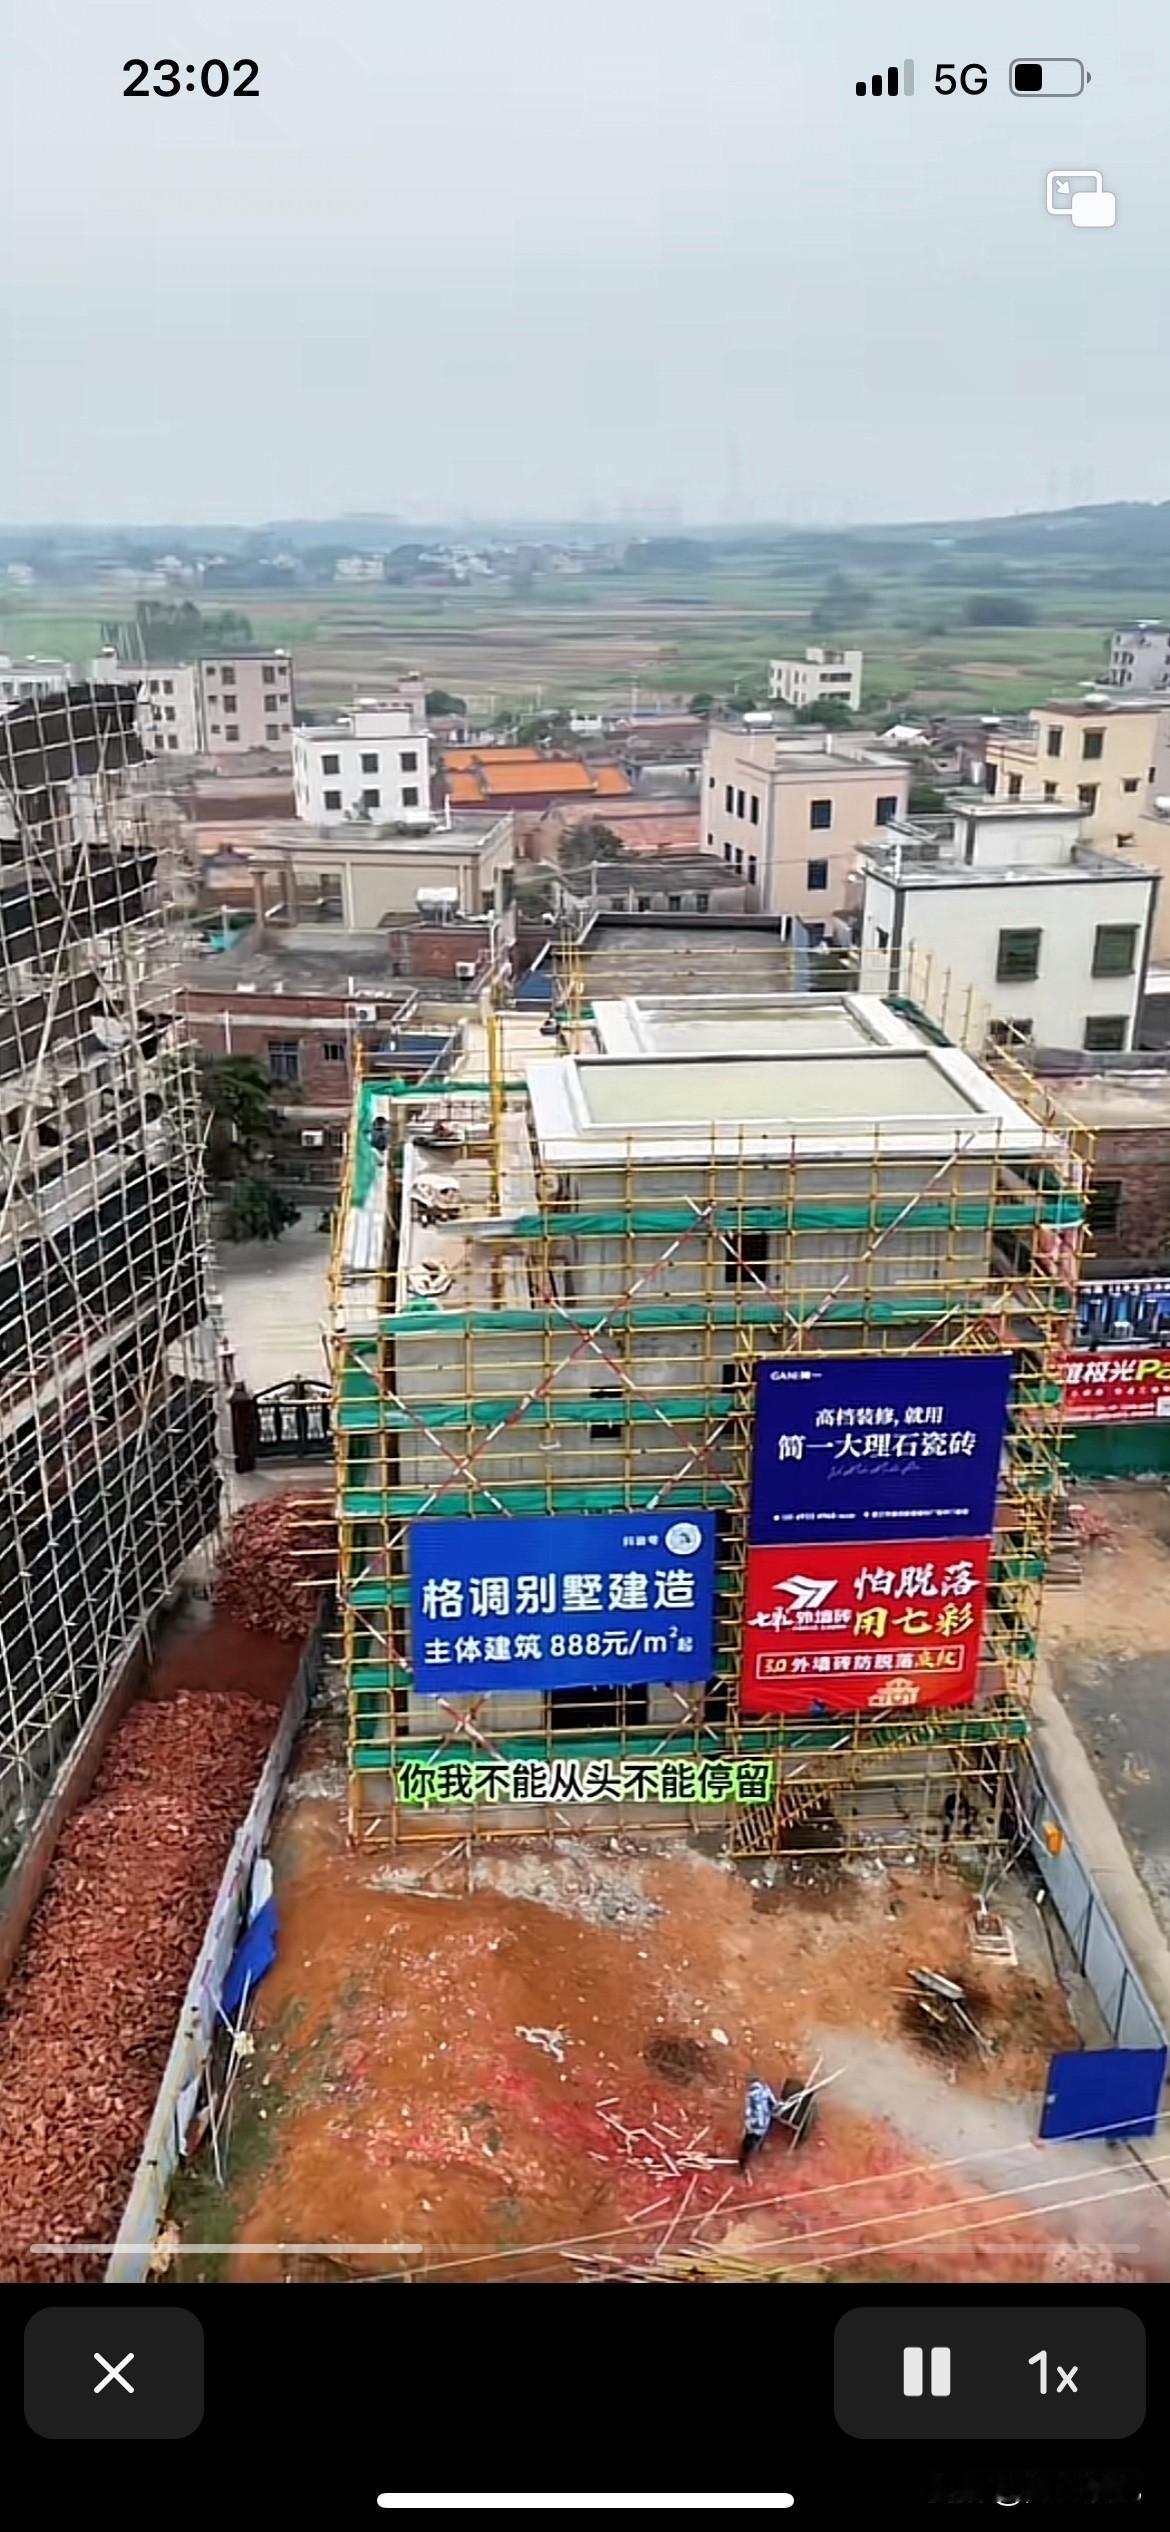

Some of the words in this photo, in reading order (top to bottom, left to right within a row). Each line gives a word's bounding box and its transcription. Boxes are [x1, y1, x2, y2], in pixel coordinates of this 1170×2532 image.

[422, 1569, 695, 1620] 格调别墅建造
[853, 1560, 981, 1601] 怕脱落
[853, 1601, 975, 1638] 用七彩
[424, 1634, 543, 1664] 主体建筑
